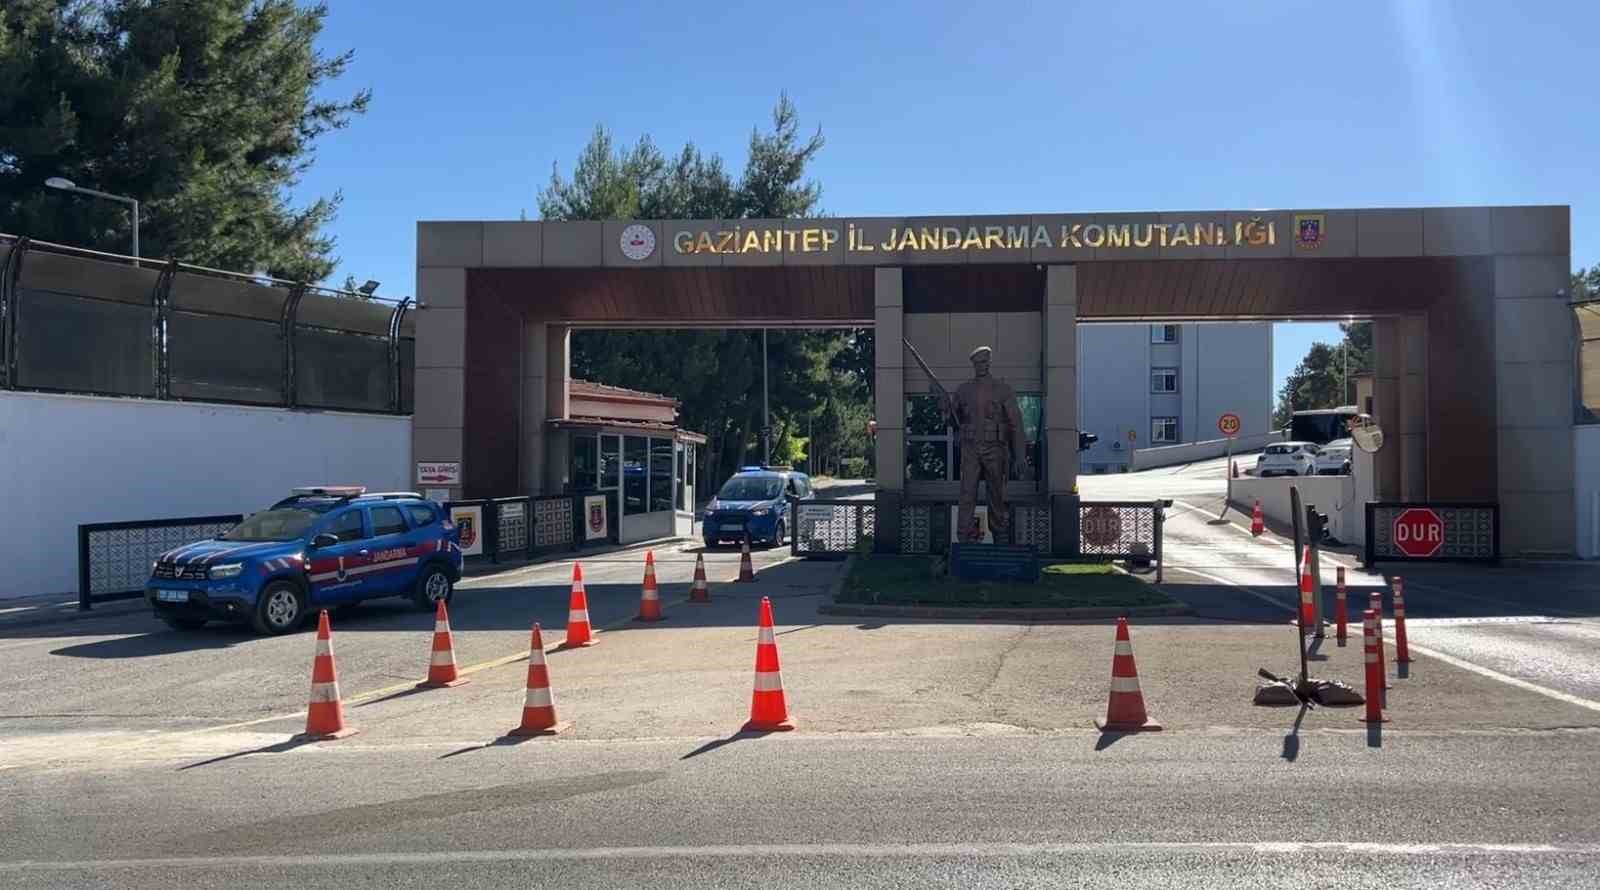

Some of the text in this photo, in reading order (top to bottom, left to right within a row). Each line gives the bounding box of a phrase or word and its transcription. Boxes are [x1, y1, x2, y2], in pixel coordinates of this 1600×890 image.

[673, 216, 1276, 254] GAZİANTEP İL JANDARMA KOMUTANLIĞI
[1223, 419, 1237, 430] 20
[1084, 519, 1120, 538] DUR
[1397, 523, 1440, 541] DUR
[372, 547, 407, 562] JANDARMA
